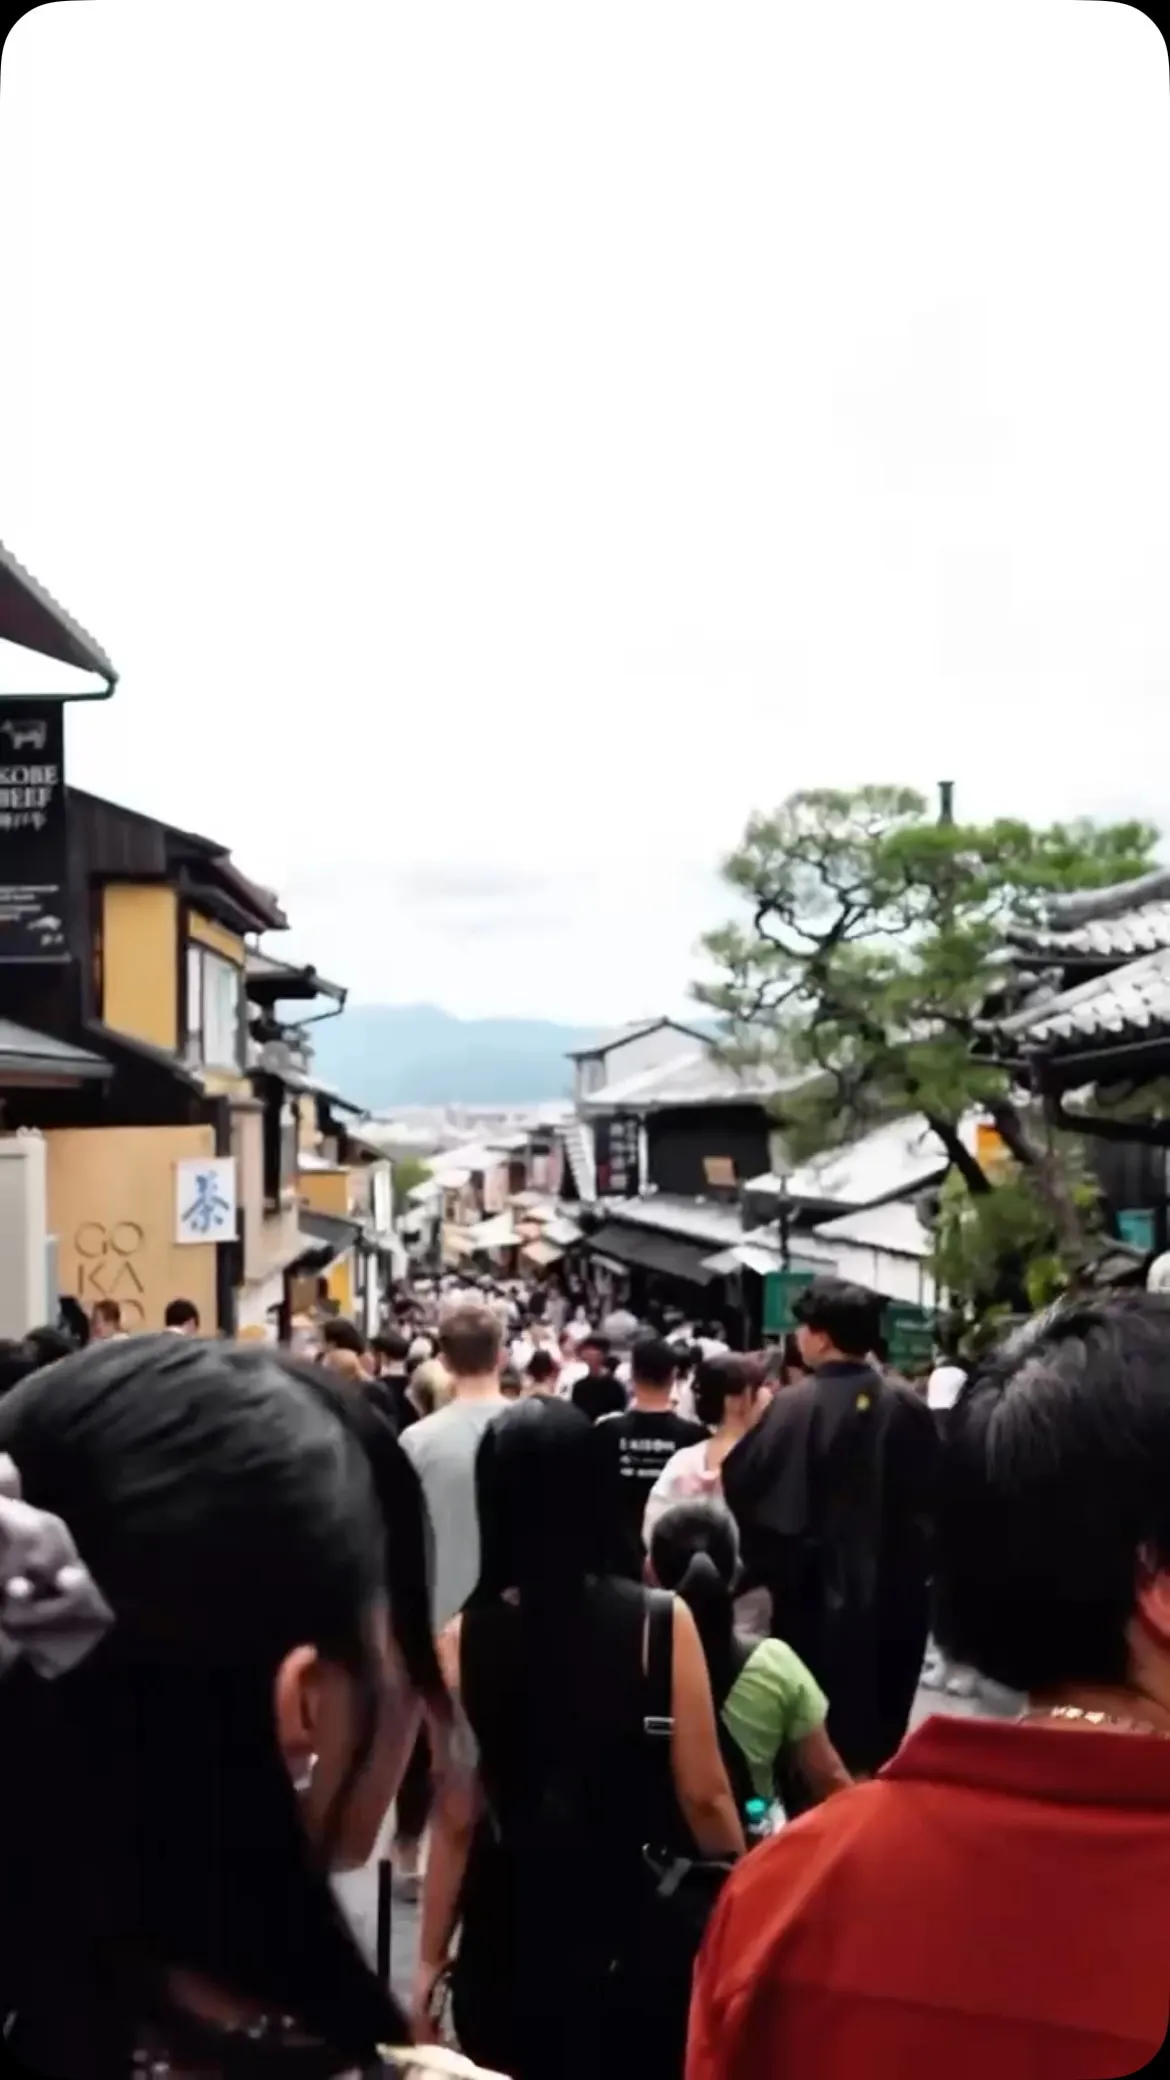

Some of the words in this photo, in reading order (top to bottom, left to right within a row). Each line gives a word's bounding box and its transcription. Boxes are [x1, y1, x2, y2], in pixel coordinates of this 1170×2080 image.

[182, 1168, 230, 1234] 茶
[74, 1221, 144, 1258] GO
[78, 1261, 144, 1297] KA
